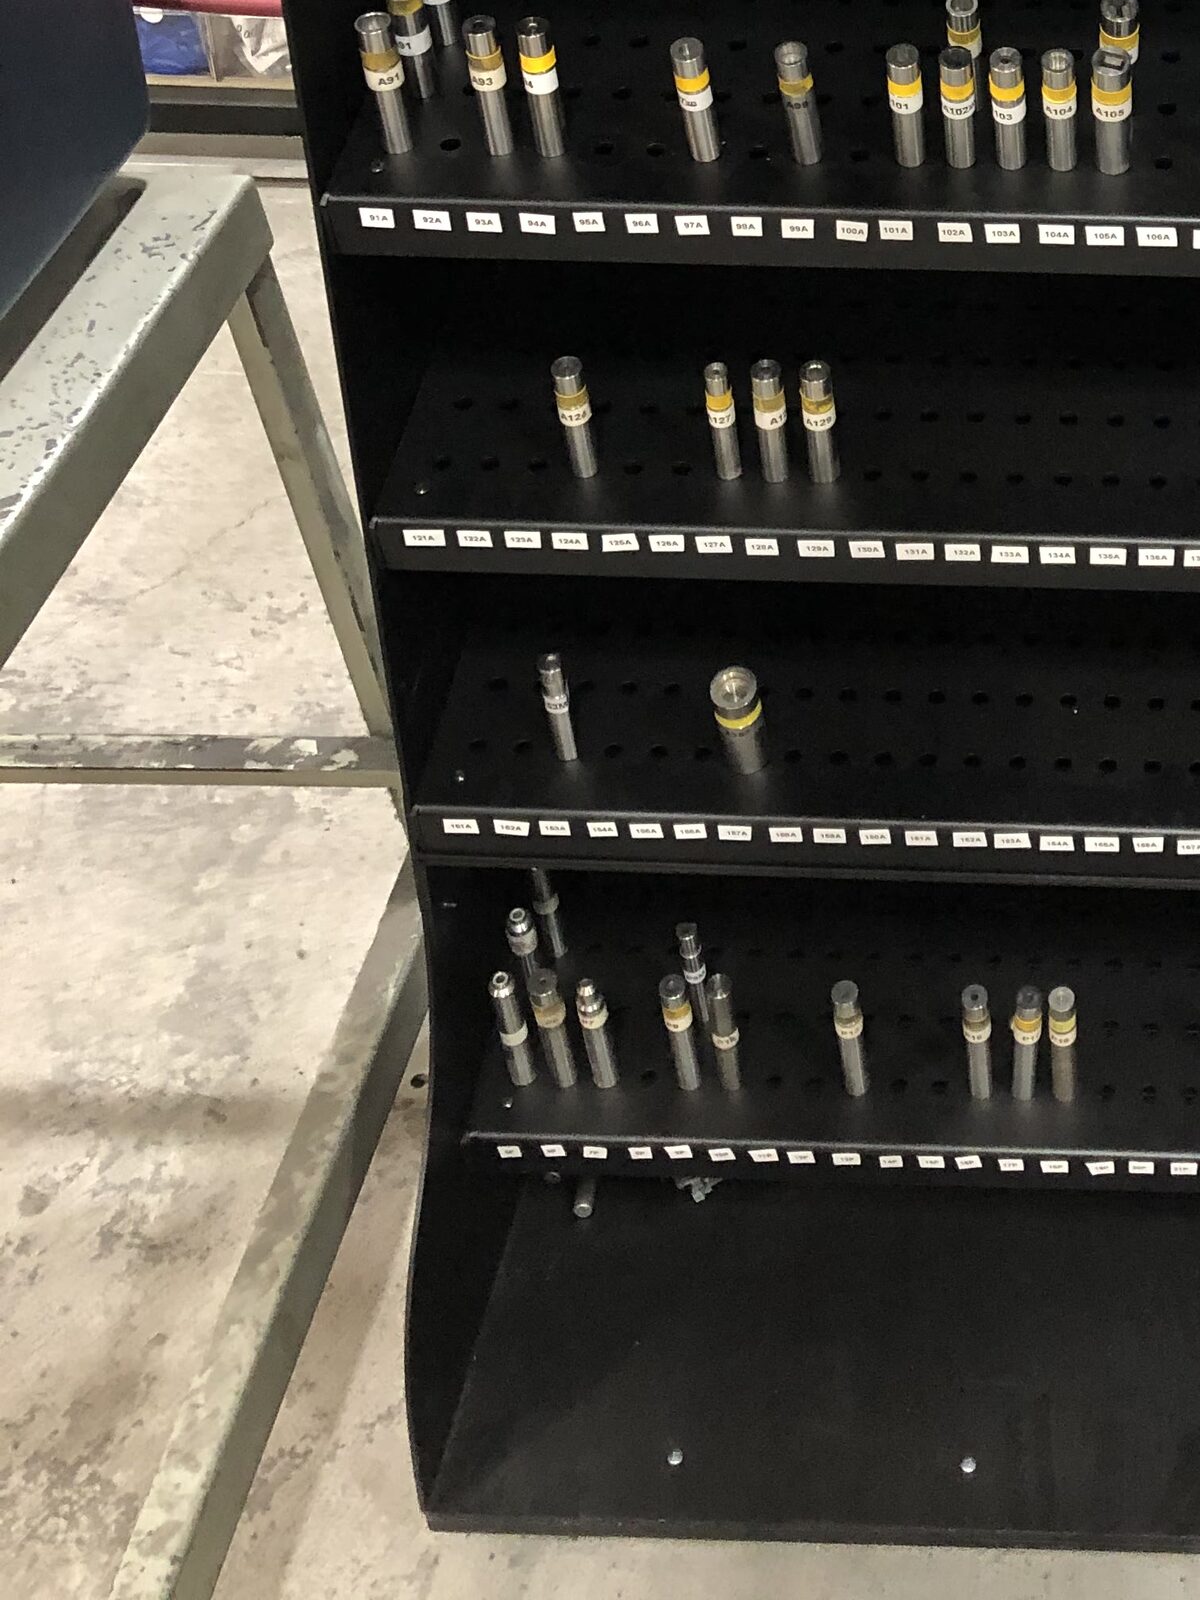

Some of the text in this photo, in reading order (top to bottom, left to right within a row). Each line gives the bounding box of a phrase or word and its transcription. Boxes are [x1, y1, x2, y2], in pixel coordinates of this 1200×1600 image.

[379, 73, 400, 85] A91
[471, 74, 494, 87] A93
[1095, 107, 1125, 118] A105
